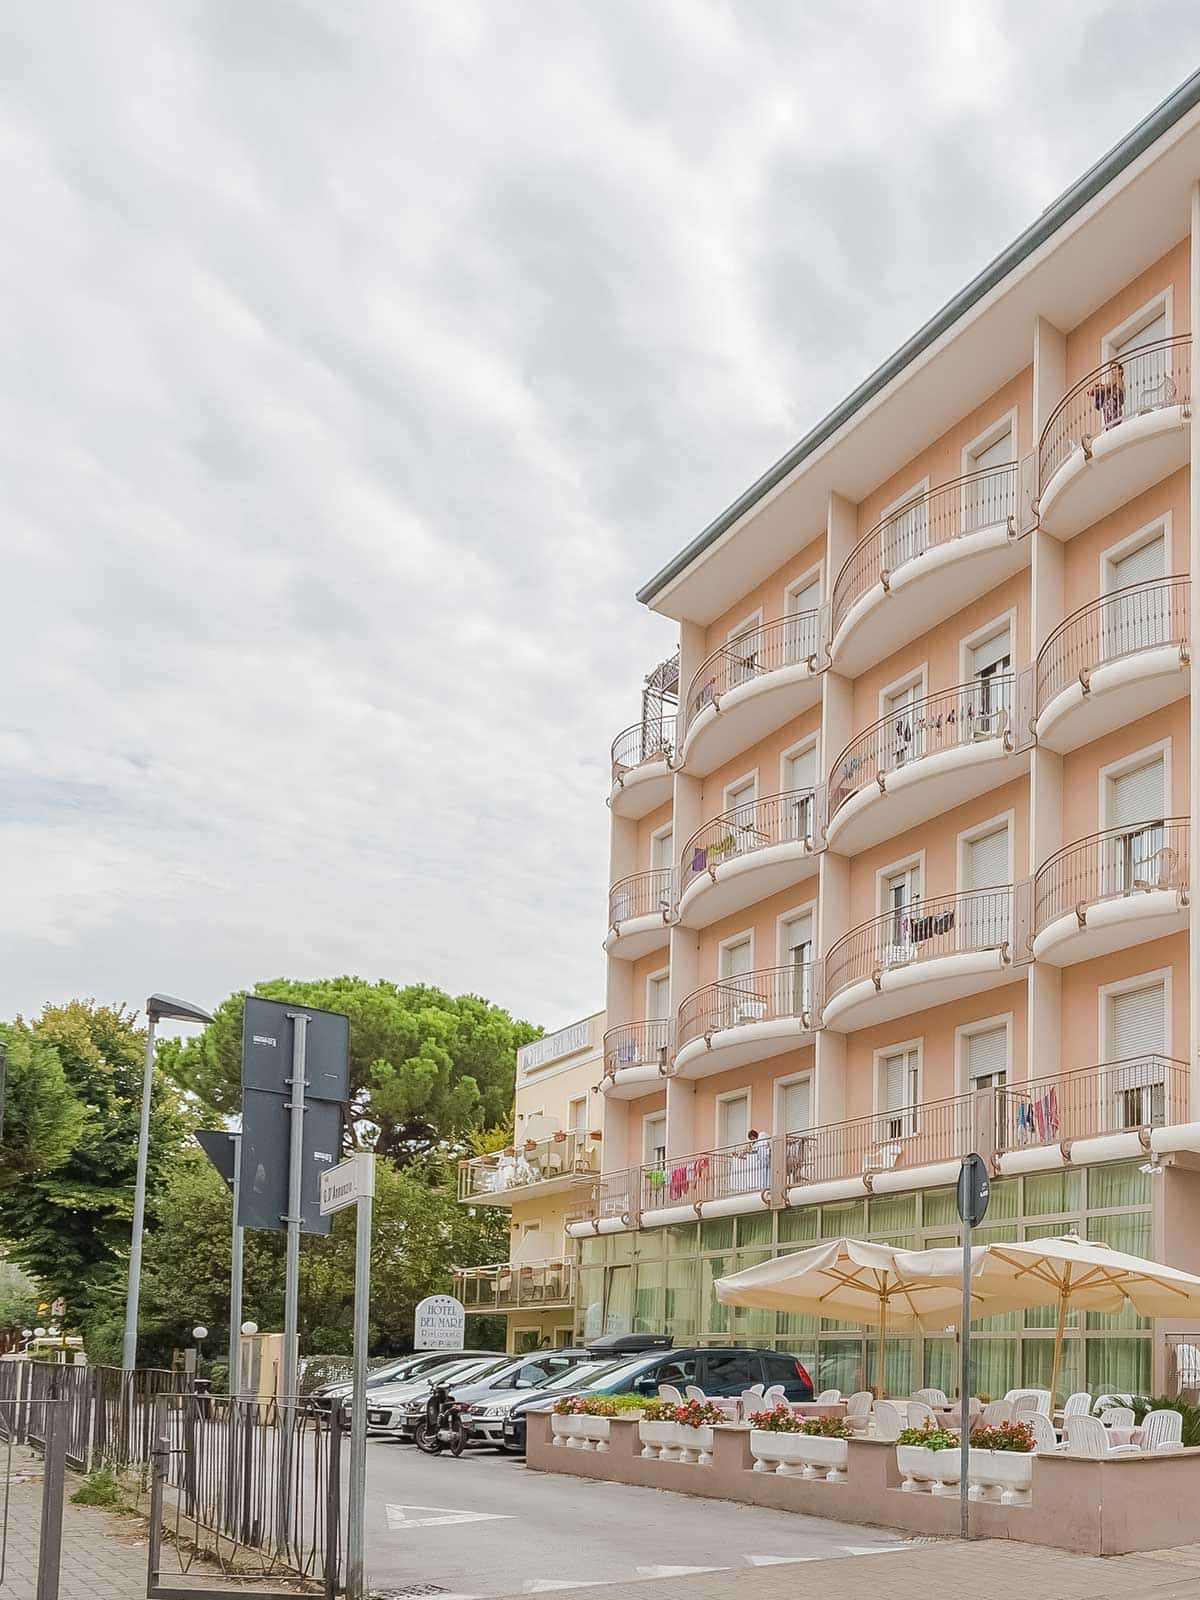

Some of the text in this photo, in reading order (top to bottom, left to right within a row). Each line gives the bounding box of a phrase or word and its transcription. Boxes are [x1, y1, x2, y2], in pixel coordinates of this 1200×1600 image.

[428, 1305, 456, 1315] HOTEL
[420, 1317, 463, 1328] BEL MARE
